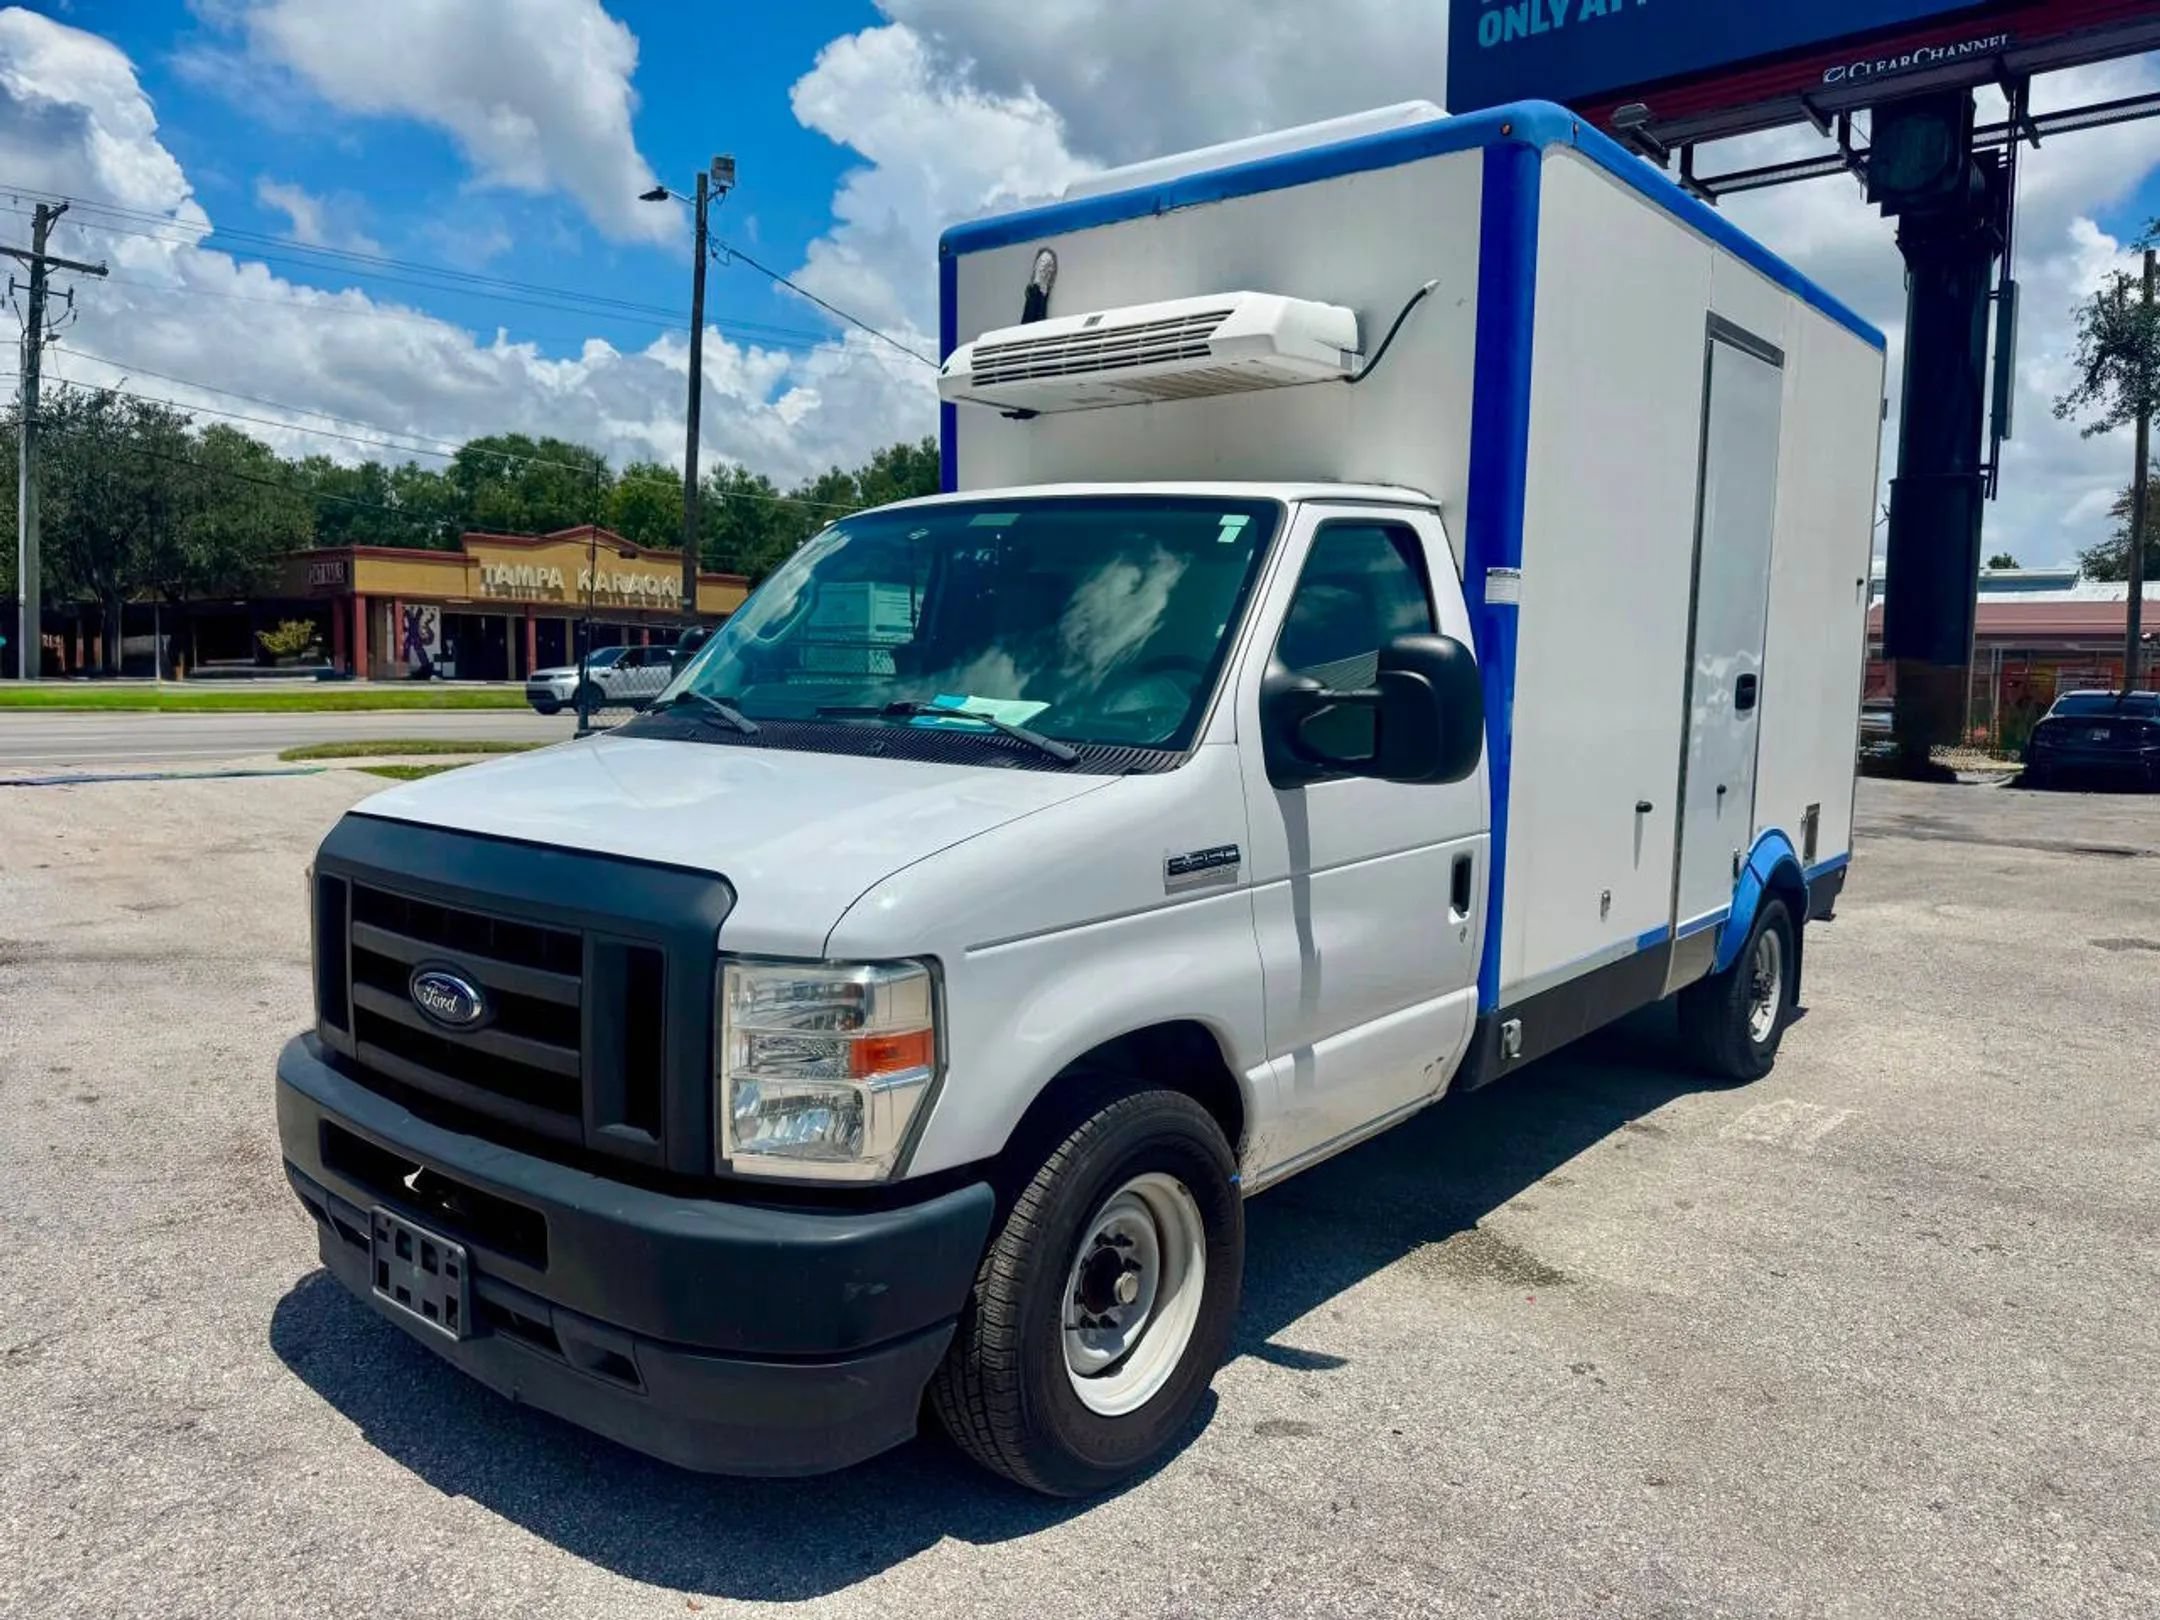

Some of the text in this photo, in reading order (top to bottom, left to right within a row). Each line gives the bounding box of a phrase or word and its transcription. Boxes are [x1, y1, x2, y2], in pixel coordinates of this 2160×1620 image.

[1478, 0, 1570, 47] ONLY
[483, 564, 566, 589] TAMPA
[423, 980, 458, 1014] Ford
